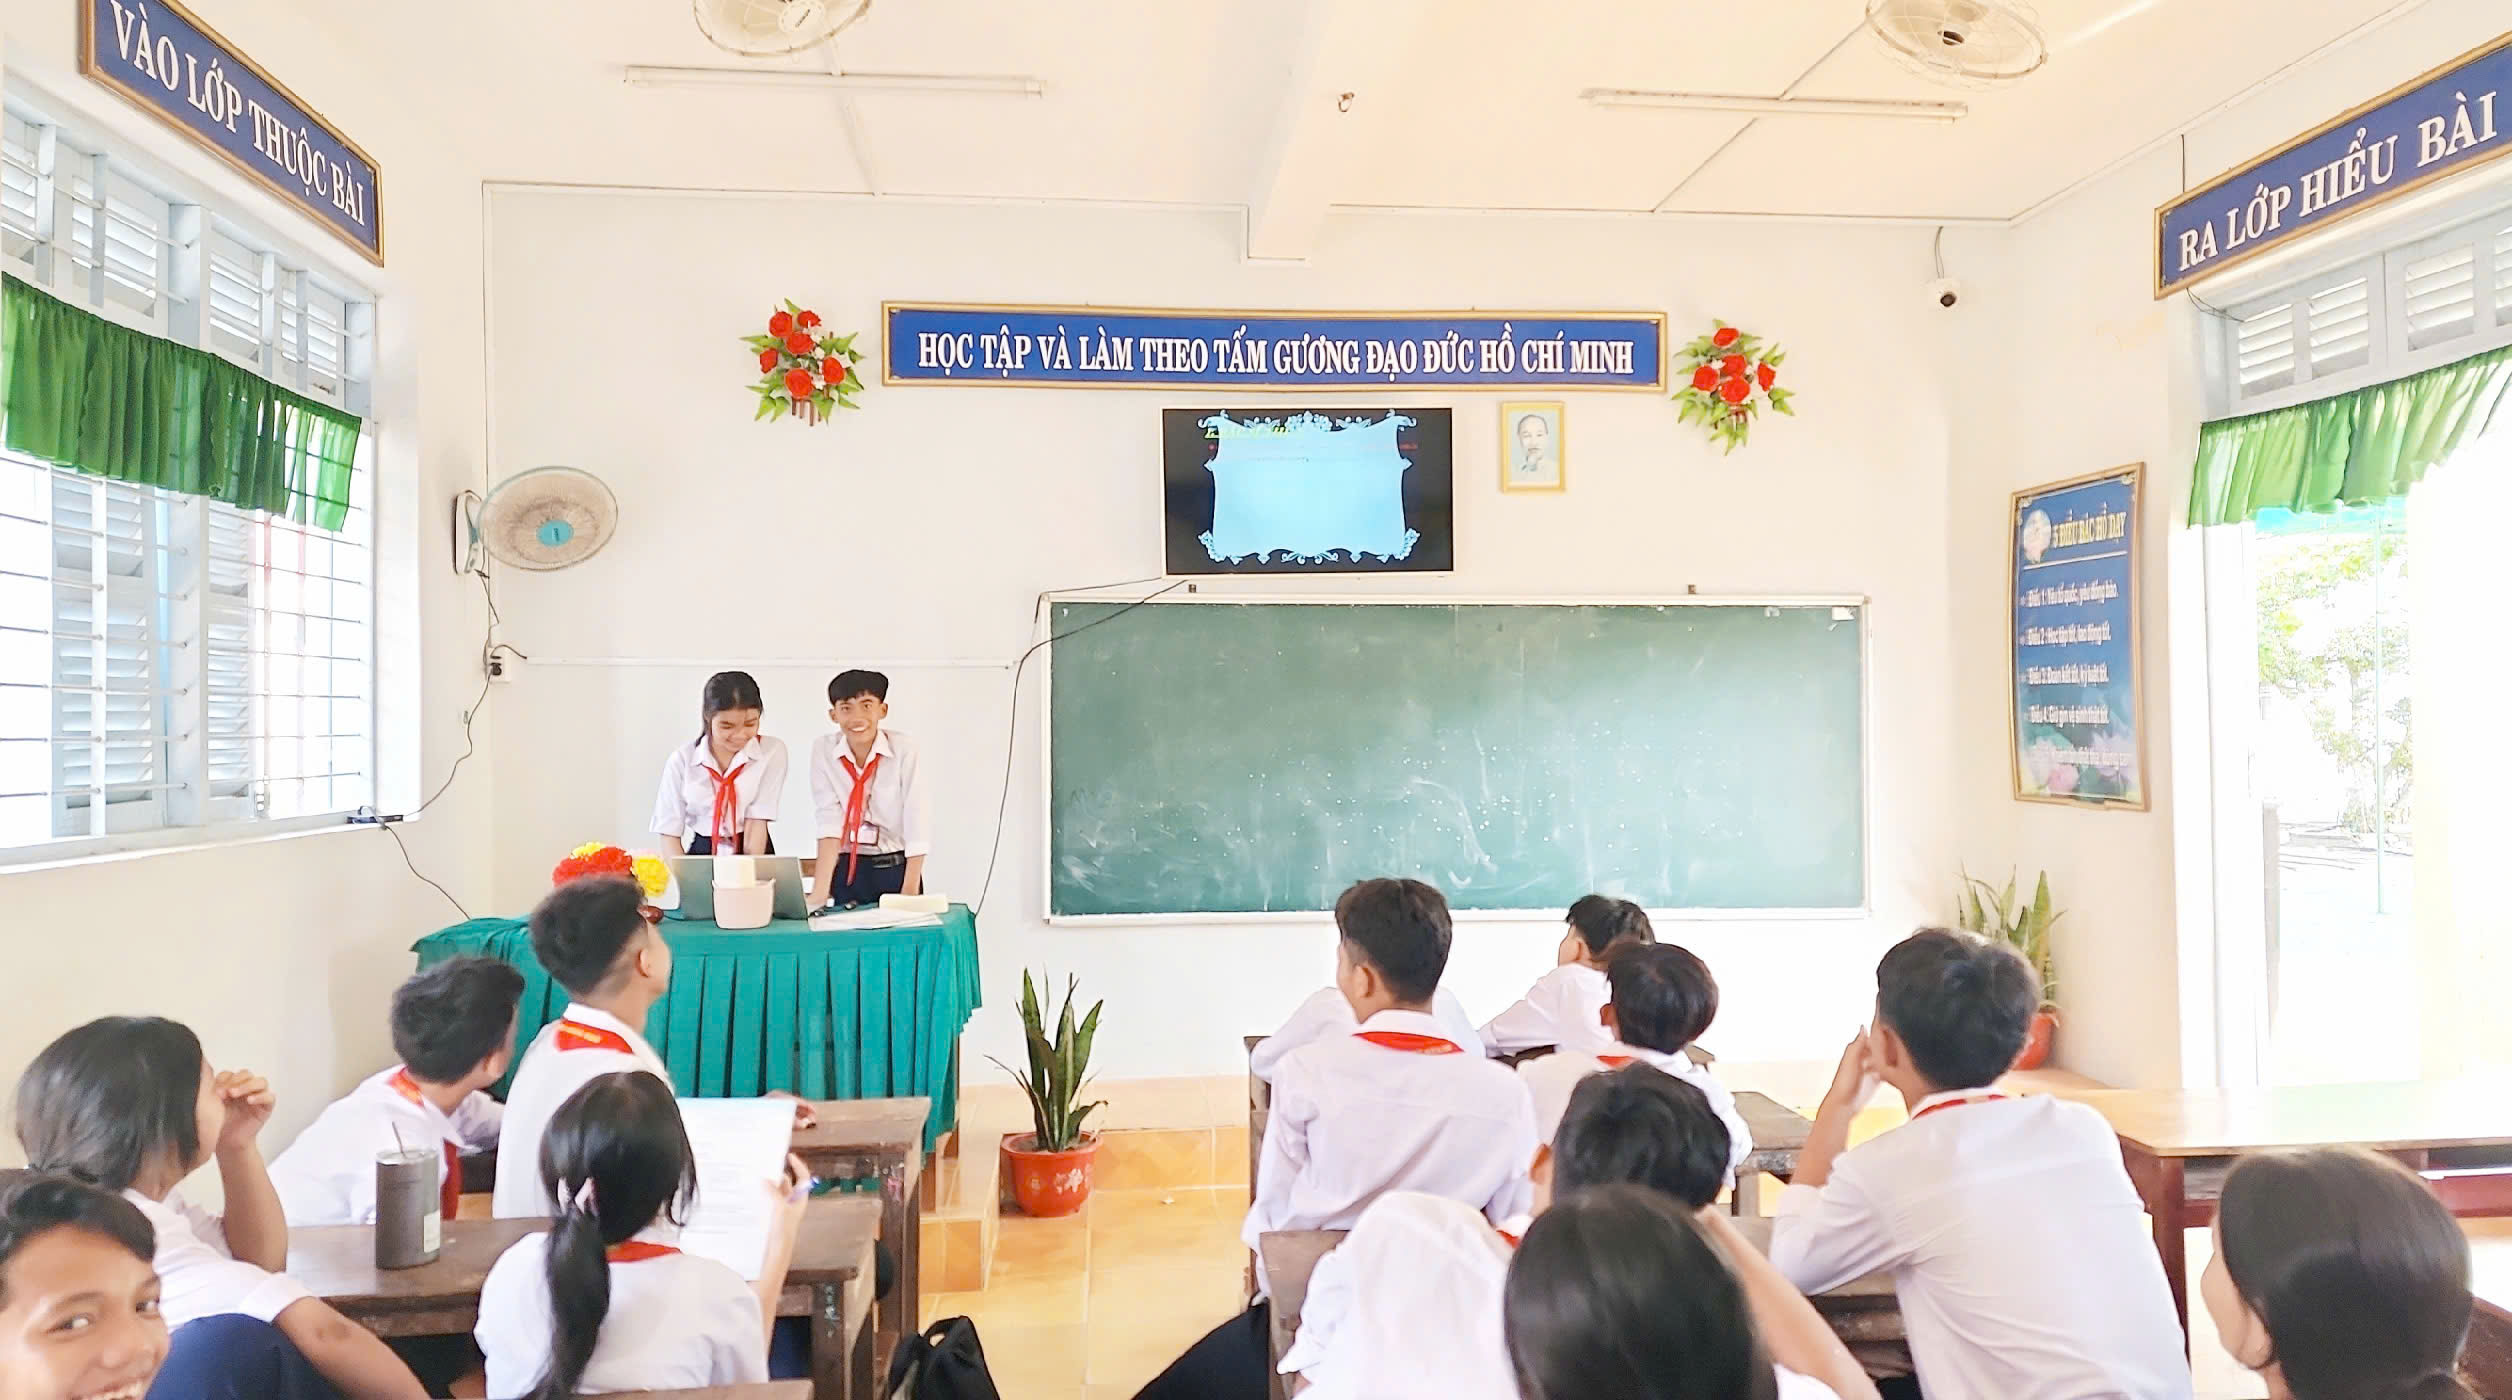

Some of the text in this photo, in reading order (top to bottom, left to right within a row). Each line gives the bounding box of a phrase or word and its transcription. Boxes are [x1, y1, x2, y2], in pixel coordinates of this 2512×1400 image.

[110, 0, 364, 226] VÀO LỚP THUỘC BÀI
[2179, 91, 2497, 272] RA LỚP HIỂU BÀI
[918, 321, 1634, 382] HỌC TẬP VÀ LÀM THEO TẤM GƯƠNG ĐẠO ĐỨC HỒ CHÍ MINH
